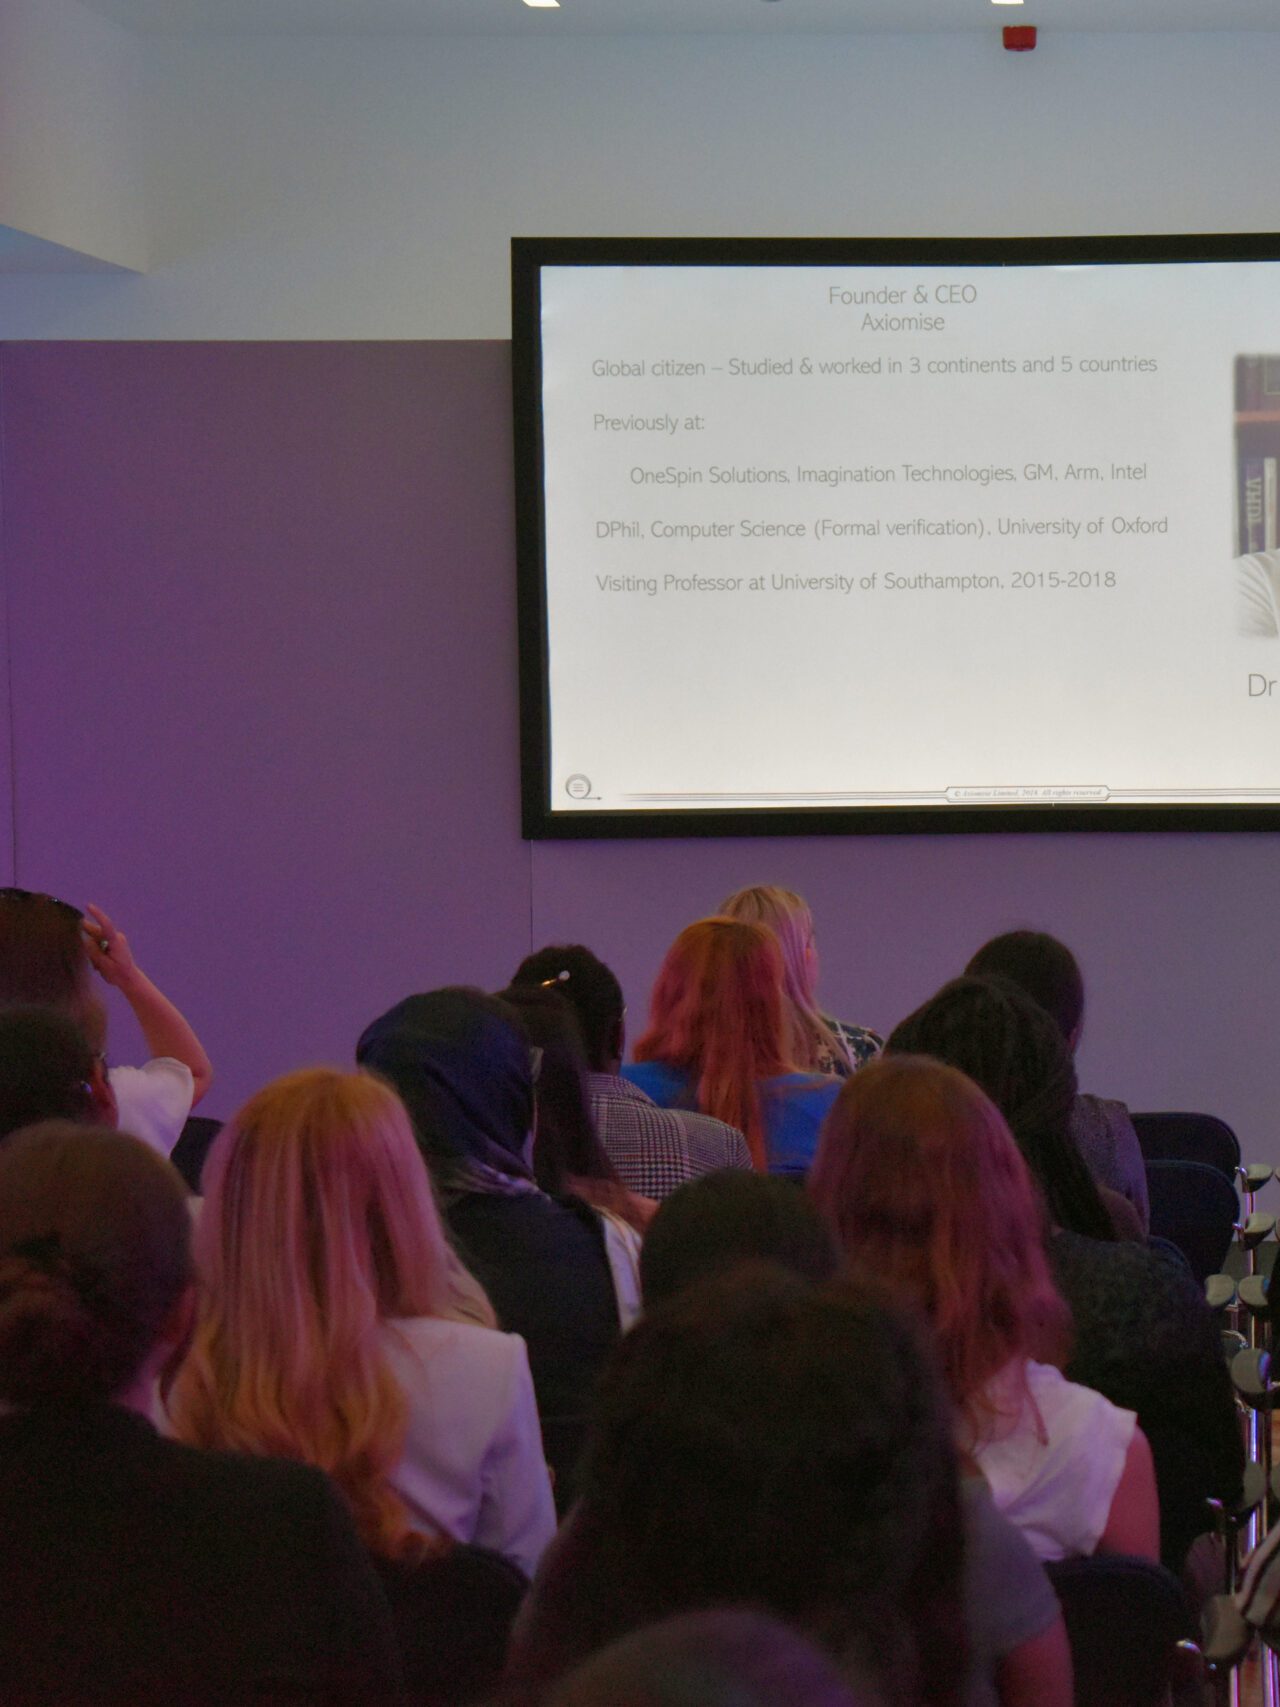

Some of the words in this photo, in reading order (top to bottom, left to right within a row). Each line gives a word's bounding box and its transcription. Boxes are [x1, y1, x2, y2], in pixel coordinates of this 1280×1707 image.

[829, 285, 907, 305] Founder
[913, 284, 929, 305] &
[934, 284, 978, 304] CEO
[861, 312, 945, 332] Axiomise
[591, 359, 645, 377] Global
[651, 359, 706, 377] citizen
[728, 357, 793, 376] Studied
[799, 357, 813, 375] &
[818, 356, 882, 375] worked
[888, 358, 903, 374] in
[909, 356, 921, 374] 3
[927, 356, 1017, 374] continents
[1022, 355, 1055, 373] and
[1061, 355, 1073, 373] 5
[1079, 355, 1158, 373] countries
[593, 413, 679, 436] Previously
[683, 415, 705, 431] at:
[630, 466, 703, 488] OneSpin
[708, 465, 791, 484] Solutions,
[797, 465, 895, 488] Imagination
[901, 464, 1017, 487] Technologies,
[1023, 463, 1058, 481] GM,
[1064, 463, 1104, 481] Arm,
[1111, 462, 1147, 481] Intel
[596, 520, 645, 539] DPhil,
[650, 520, 735, 541] Computer
[740, 519, 806, 538] Science
[814, 519, 881, 541] (Formal
[885, 518, 992, 539] verification),
[997, 517, 1082, 540] University
[1086, 516, 1105, 535] of
[1111, 516, 1169, 535] Oxford
[595, 575, 658, 597] Visiting
[663, 573, 744, 592] Professor
[748, 575, 766, 591] at
[771, 573, 855, 595] University
[859, 572, 877, 590] of
[884, 571, 1005, 593] Southampton,
[1011, 570, 1117, 589] 2015-2018
[1248, 673, 1278, 697] Dr
